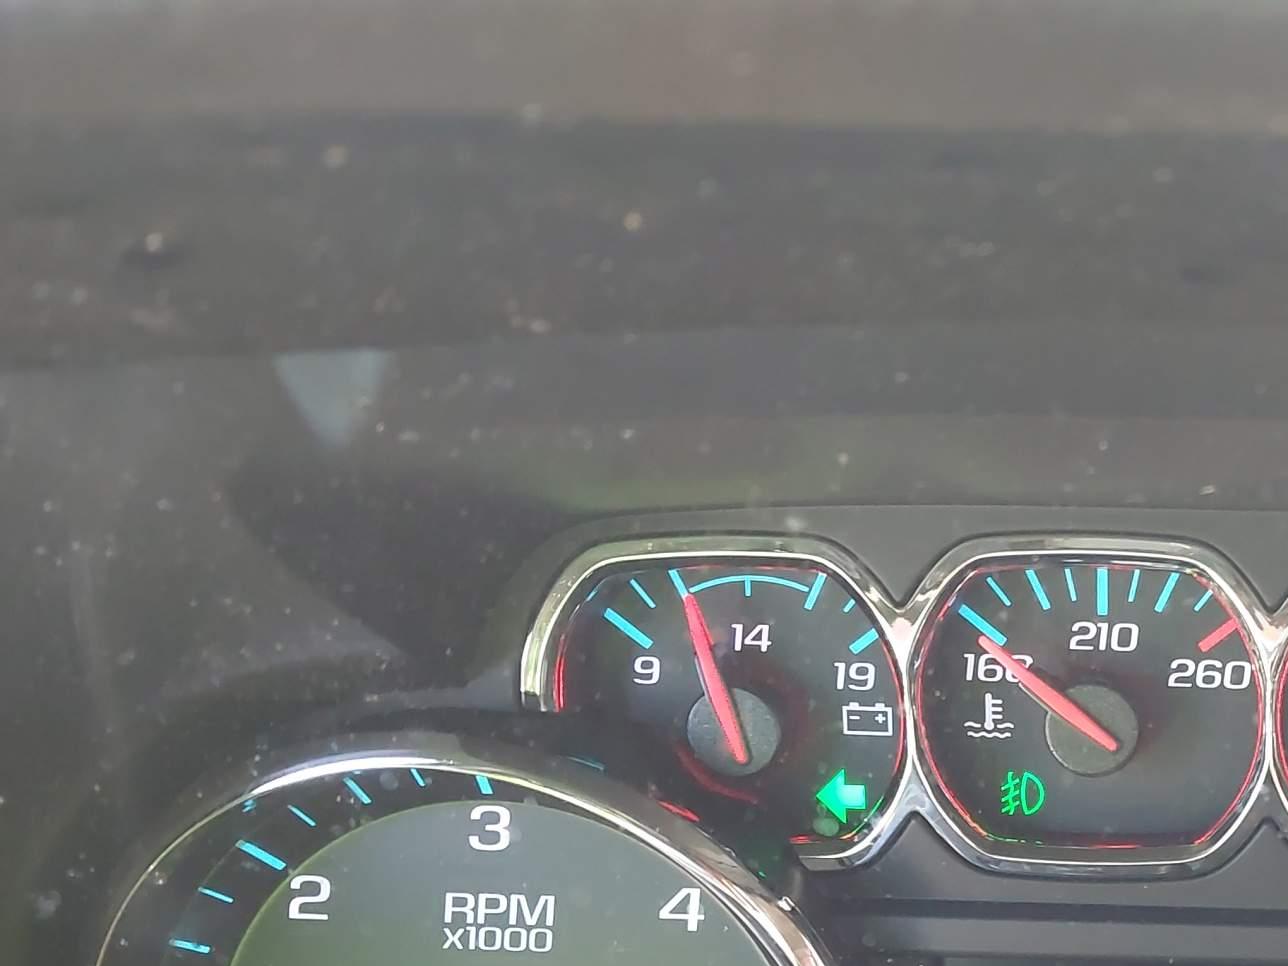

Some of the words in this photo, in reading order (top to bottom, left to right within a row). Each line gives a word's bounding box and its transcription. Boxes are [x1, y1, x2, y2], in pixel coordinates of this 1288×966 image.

[731, 623, 772, 652] 14
[1069, 621, 1139, 652] 210
[633, 656, 661, 685] 9
[833, 662, 876, 690] 19
[1167, 660, 1253, 690] 260
[468, 805, 511, 851] 3
[288, 874, 331, 921] 2
[444, 892, 556, 926] RPM
[658, 886, 706, 932] 4
[442, 927, 554, 953] x1000
